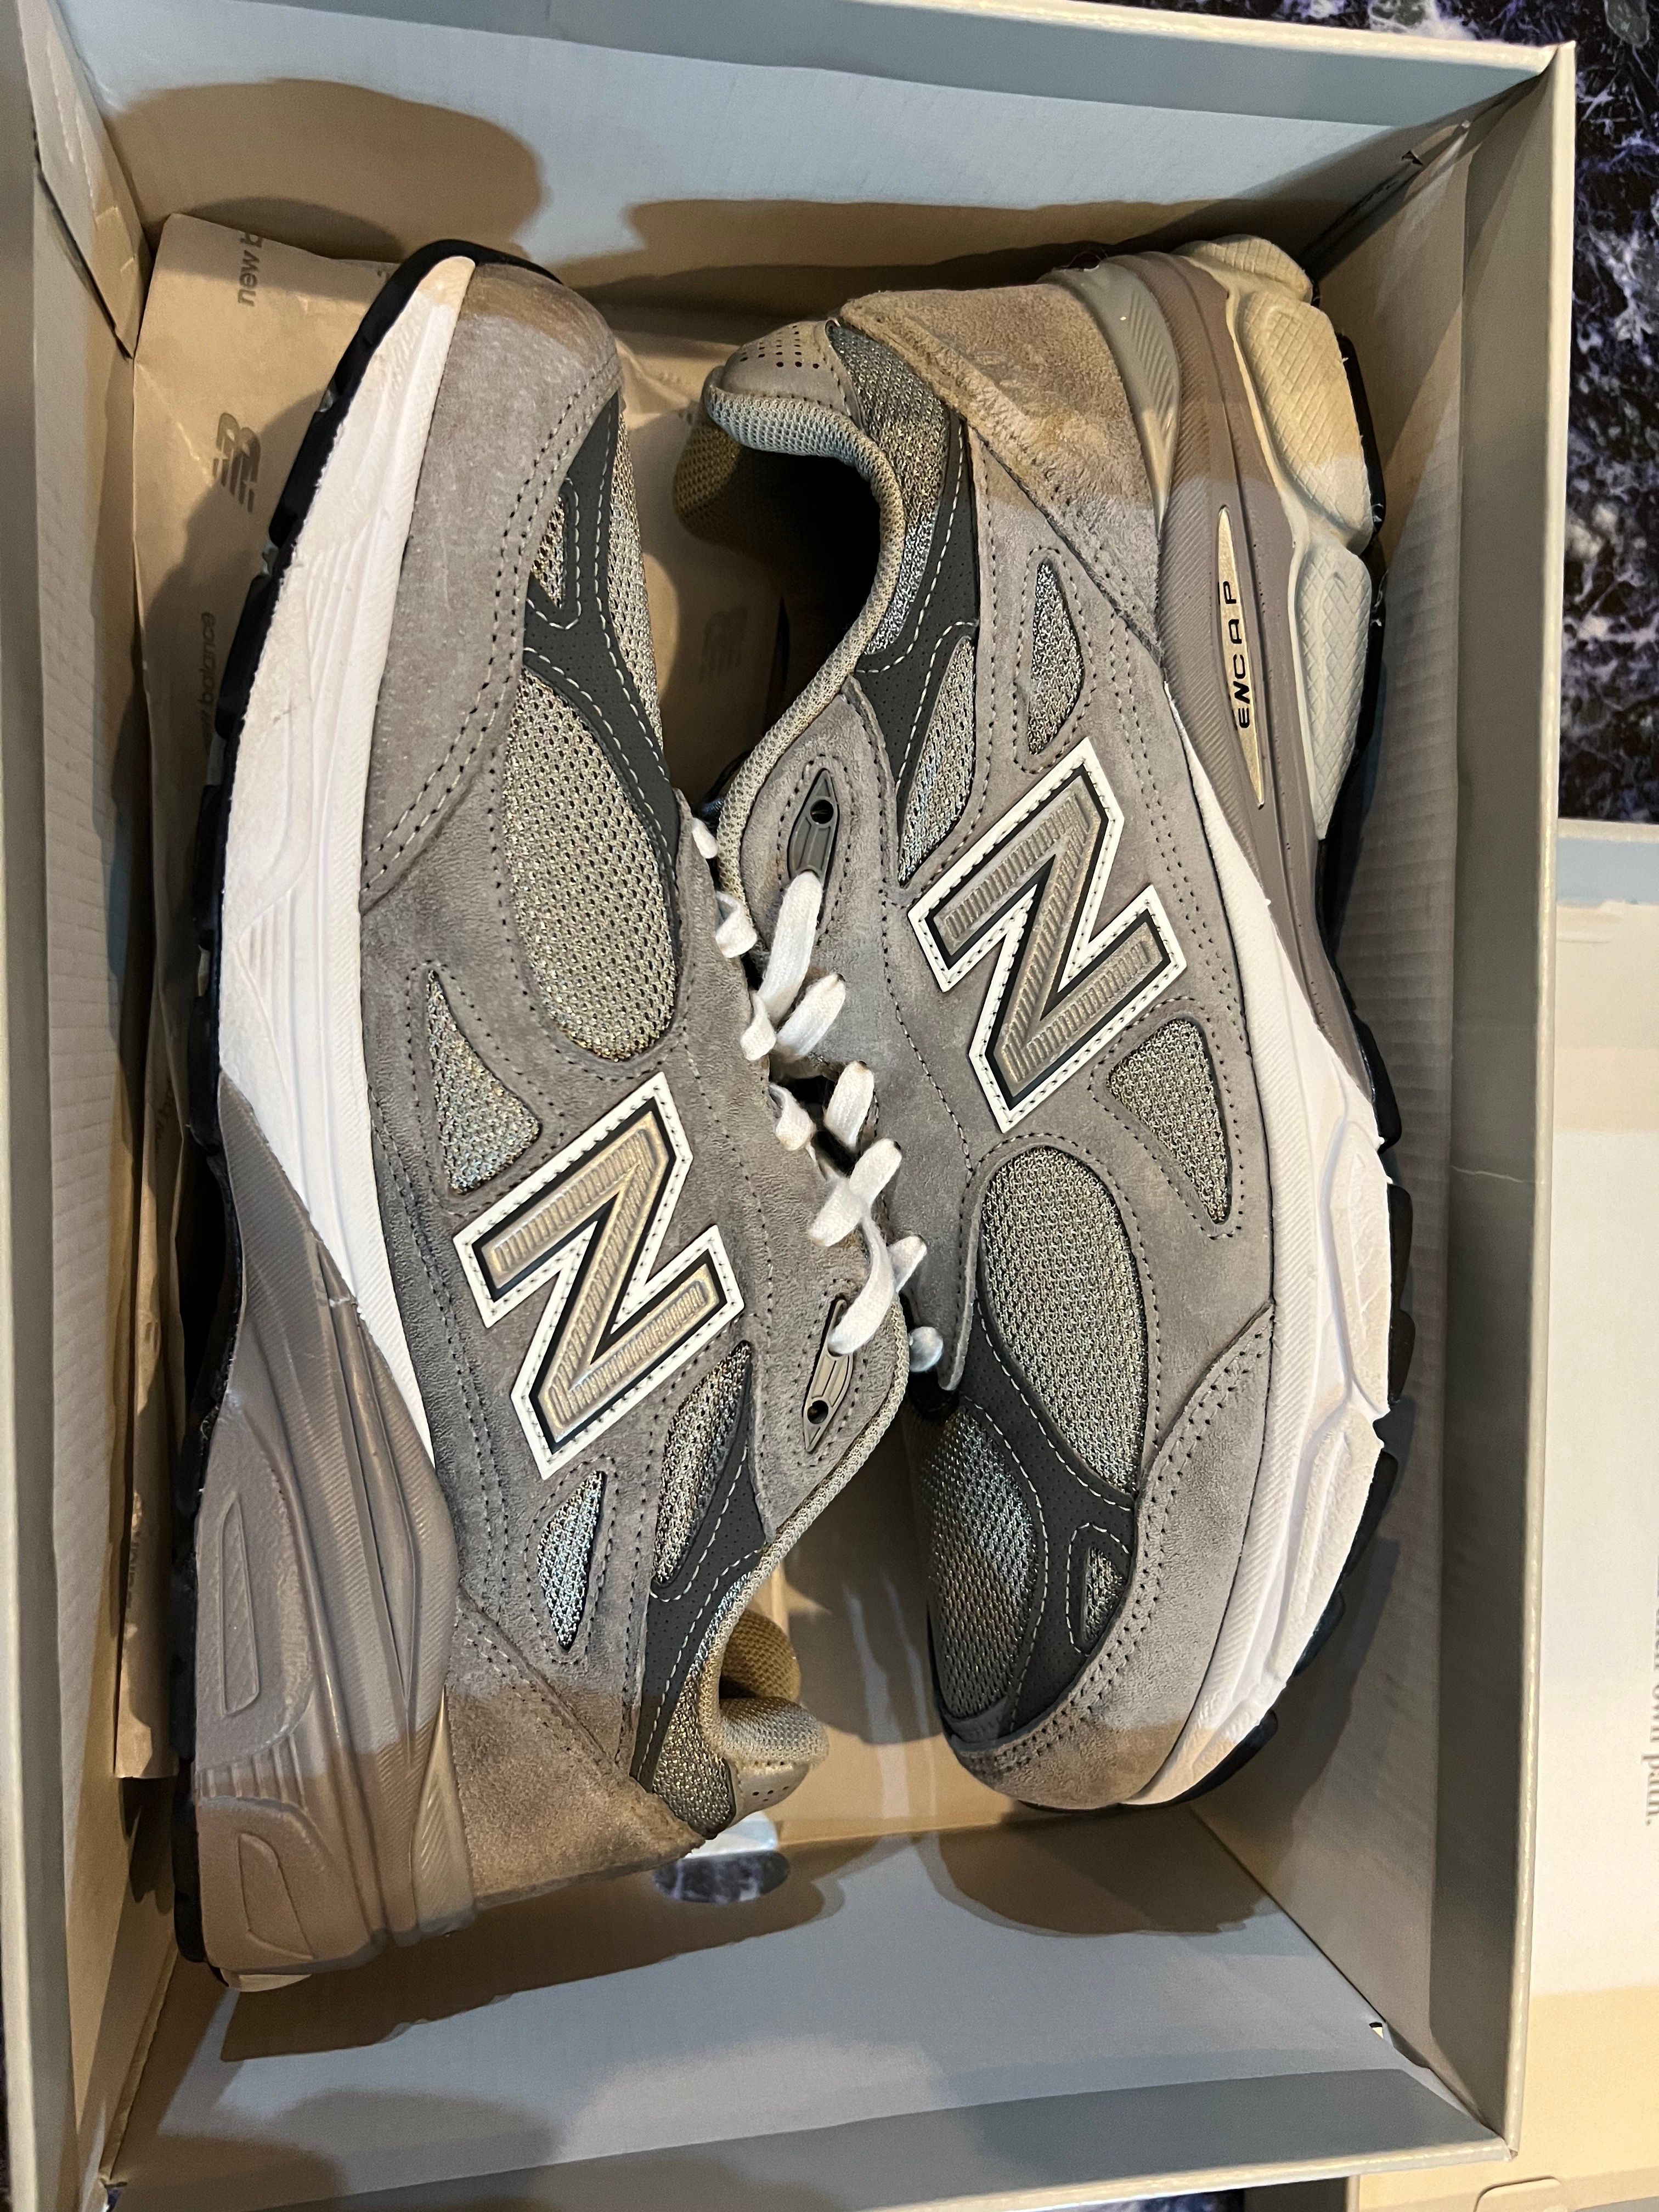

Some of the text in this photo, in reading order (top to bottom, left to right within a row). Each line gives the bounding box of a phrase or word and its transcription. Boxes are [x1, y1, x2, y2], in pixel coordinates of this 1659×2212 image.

[238, 250, 260, 307] new
[907, 736, 1188, 1133] N
[453, 1071, 745, 1480] N
